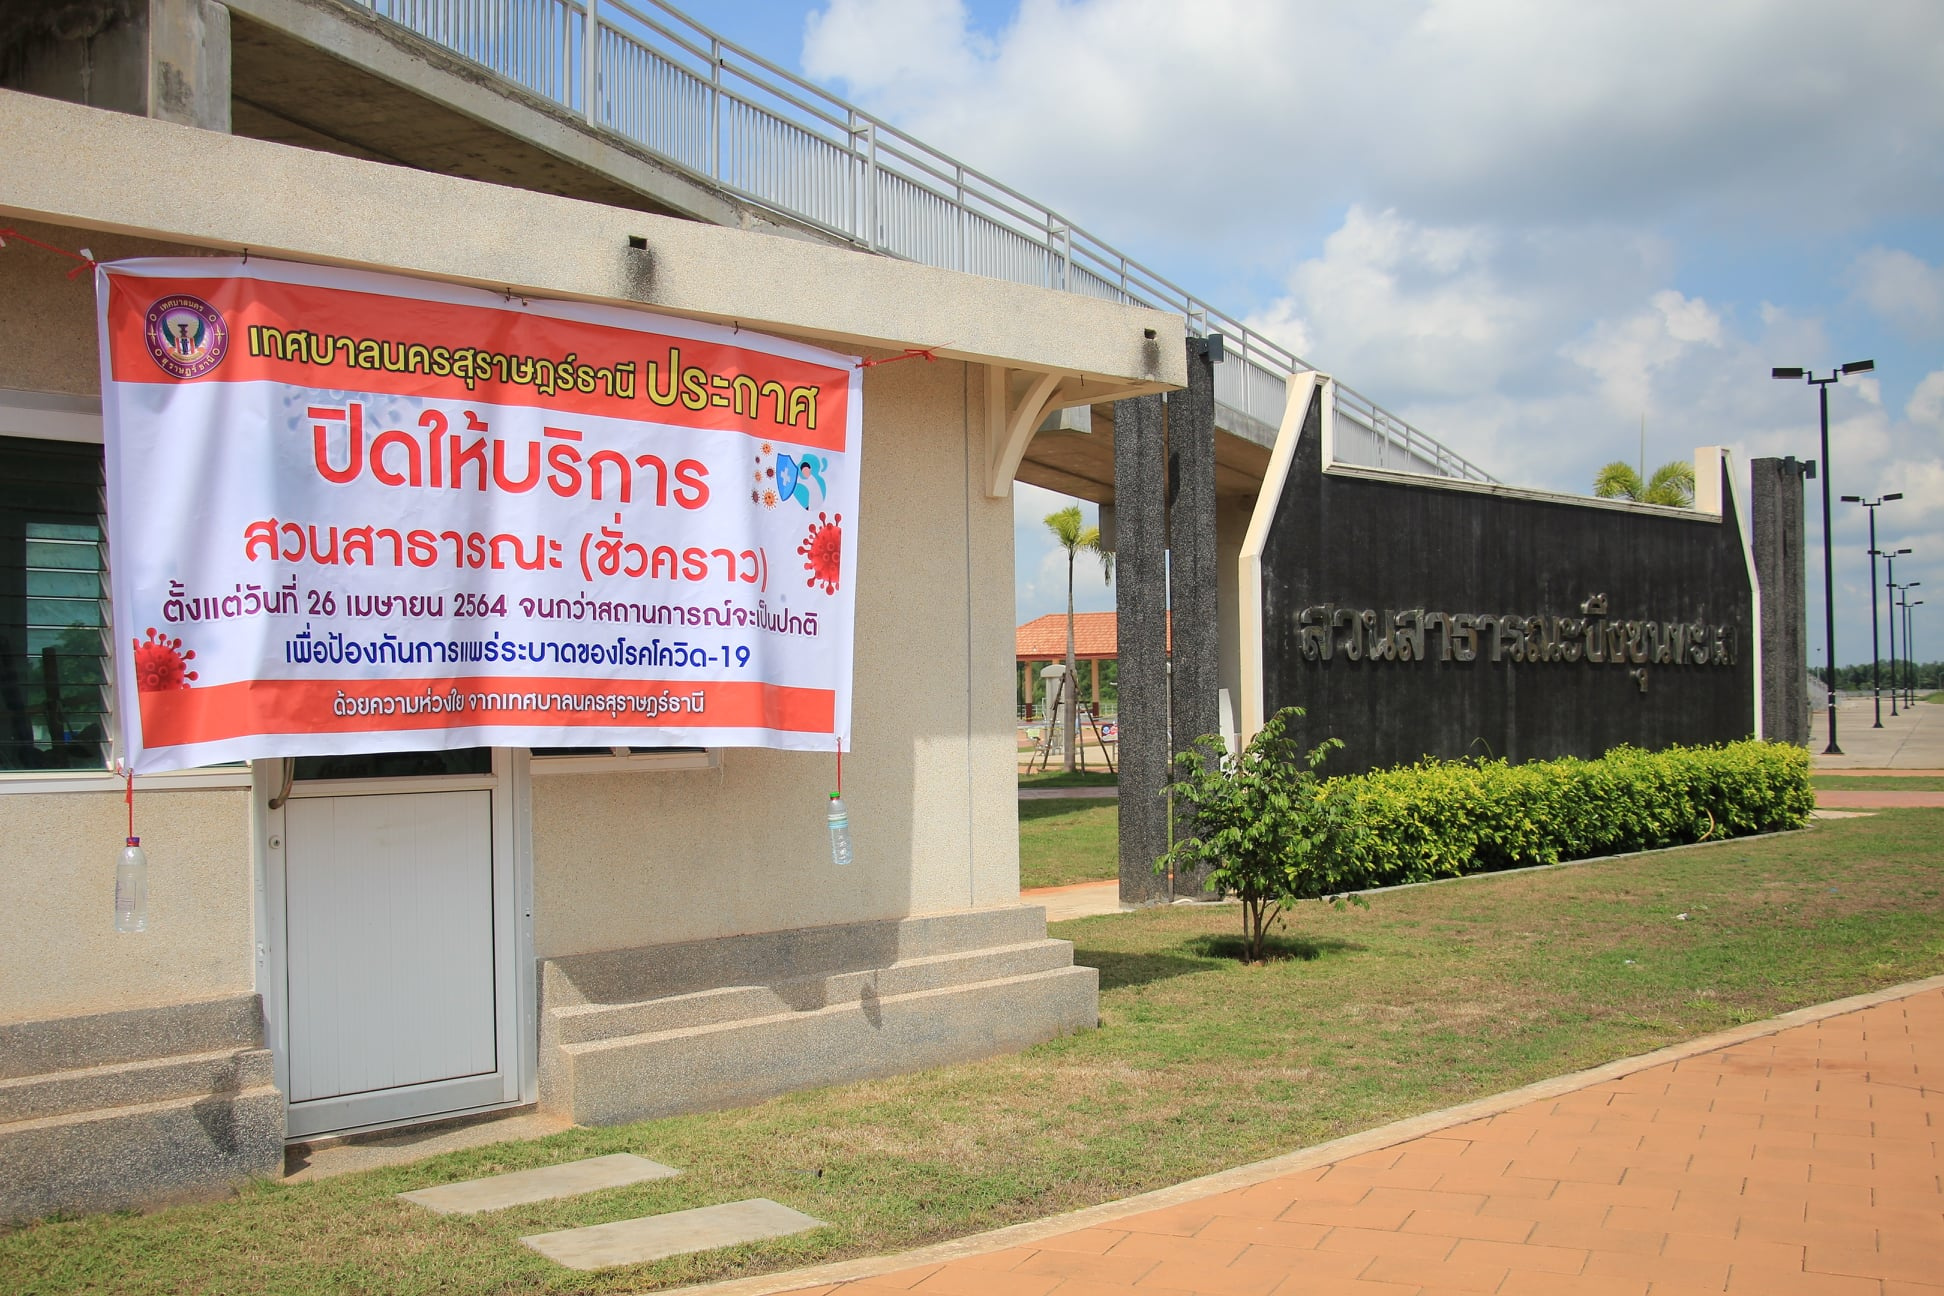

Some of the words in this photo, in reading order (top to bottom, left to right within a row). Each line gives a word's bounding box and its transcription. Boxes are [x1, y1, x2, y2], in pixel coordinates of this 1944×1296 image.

[646, 346, 819, 430] ประกาศ
[307, 402, 711, 511] ปิดให้บริการ
[244, 517, 563, 571] สวนสาธารณะ
[579, 512, 768, 593] (ชั่วคราว)
[163, 574, 299, 623] ตั้งแต่วันที่
[308, 590, 335, 617] 26
[347, 592, 443, 618] เมษายน
[453, 592, 508, 618] 2564
[519, 591, 818, 637] จนกว่าสถานการณ์จะเป็นปกติ
[286, 622, 751, 669] เพื่อป้องกันการแพร่ระบาดของโรคโควิด-19
[333, 688, 464, 716] ด้วยความห่วงใย
